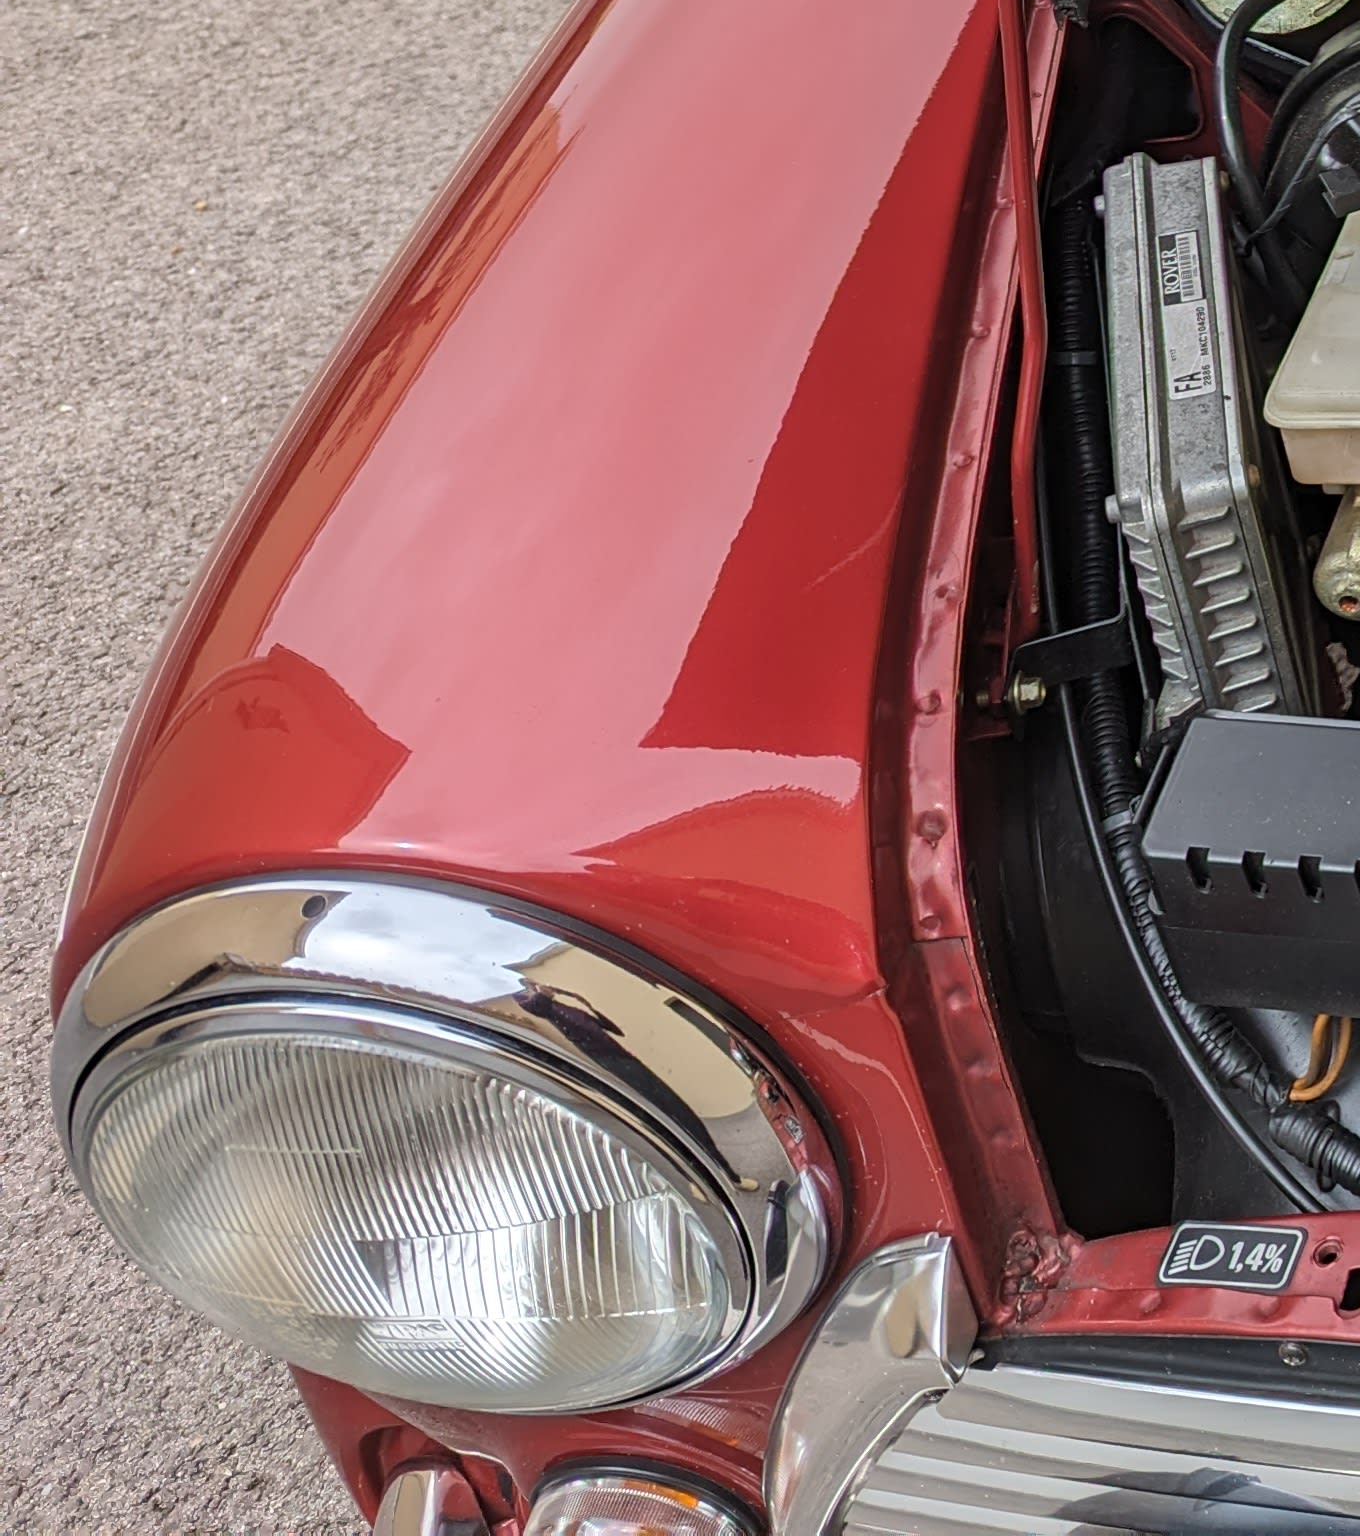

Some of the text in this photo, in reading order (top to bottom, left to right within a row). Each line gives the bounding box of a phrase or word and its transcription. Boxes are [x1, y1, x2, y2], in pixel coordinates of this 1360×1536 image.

[1161, 248, 1181, 295] ROVER
[1173, 370, 1203, 394] FA
[1227, 1240, 1288, 1274] 1,4%
